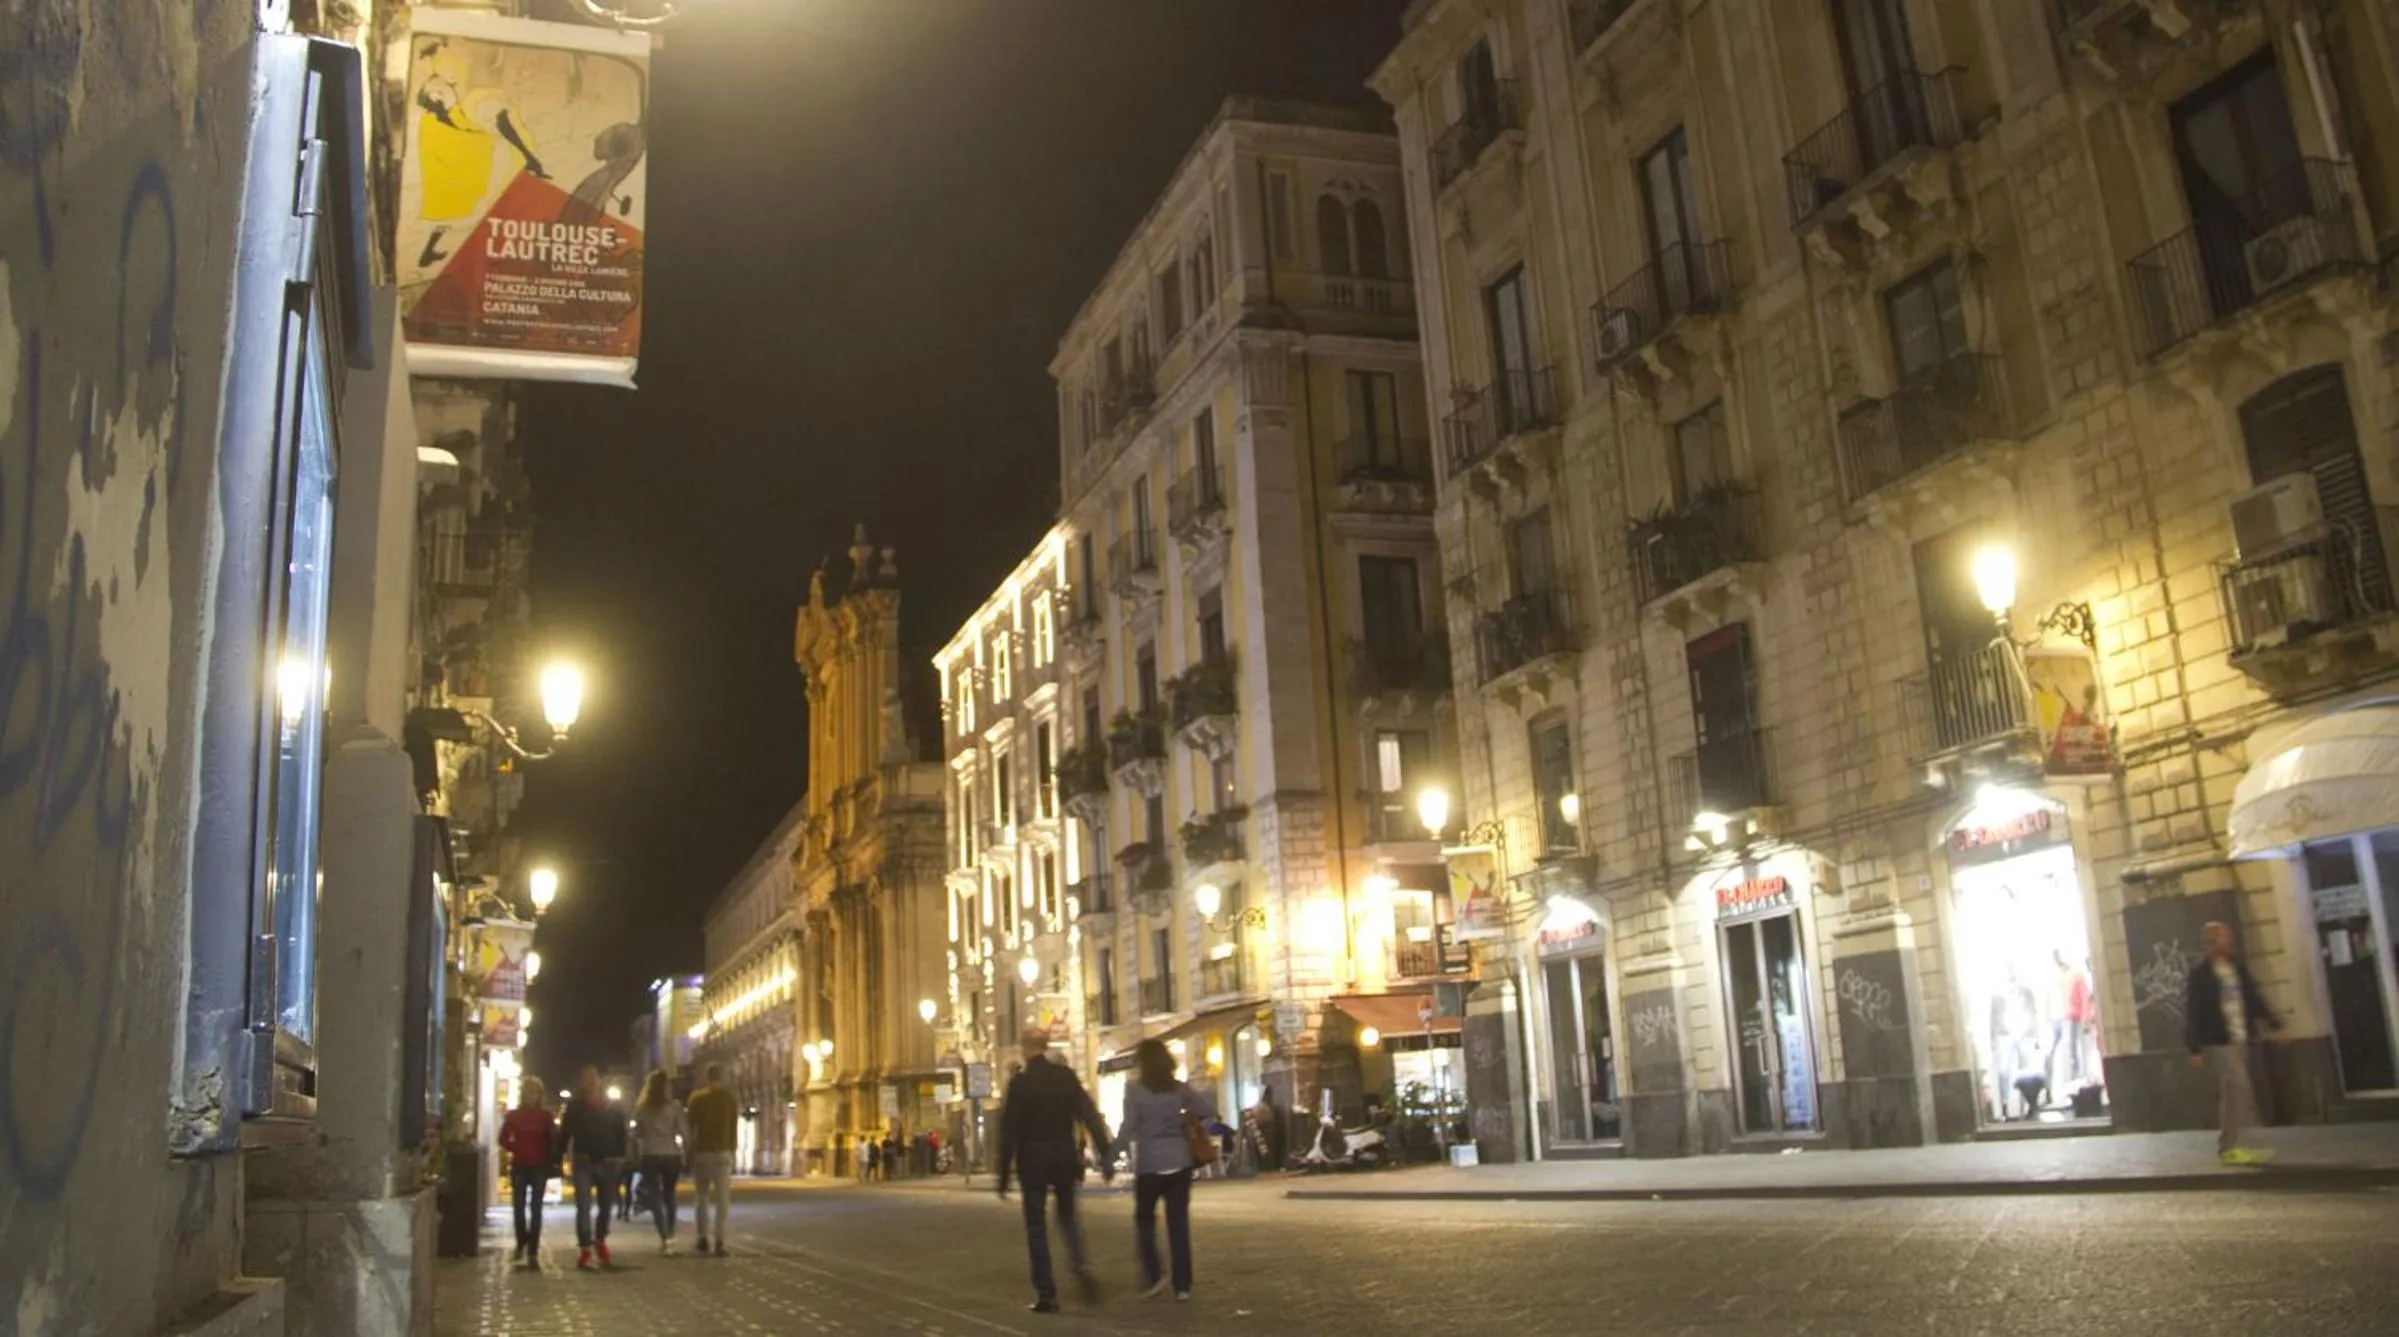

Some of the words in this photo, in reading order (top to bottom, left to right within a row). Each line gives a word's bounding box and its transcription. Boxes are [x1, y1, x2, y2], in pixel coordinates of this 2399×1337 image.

[487, 217, 628, 248] TOULOUSE-
[486, 238, 599, 264] LAUTREC
[483, 281, 538, 296] PALAZZO
[539, 285, 577, 299] DELLA
[578, 288, 632, 302] CULTURA
[482, 301, 540, 315] CATANIA
